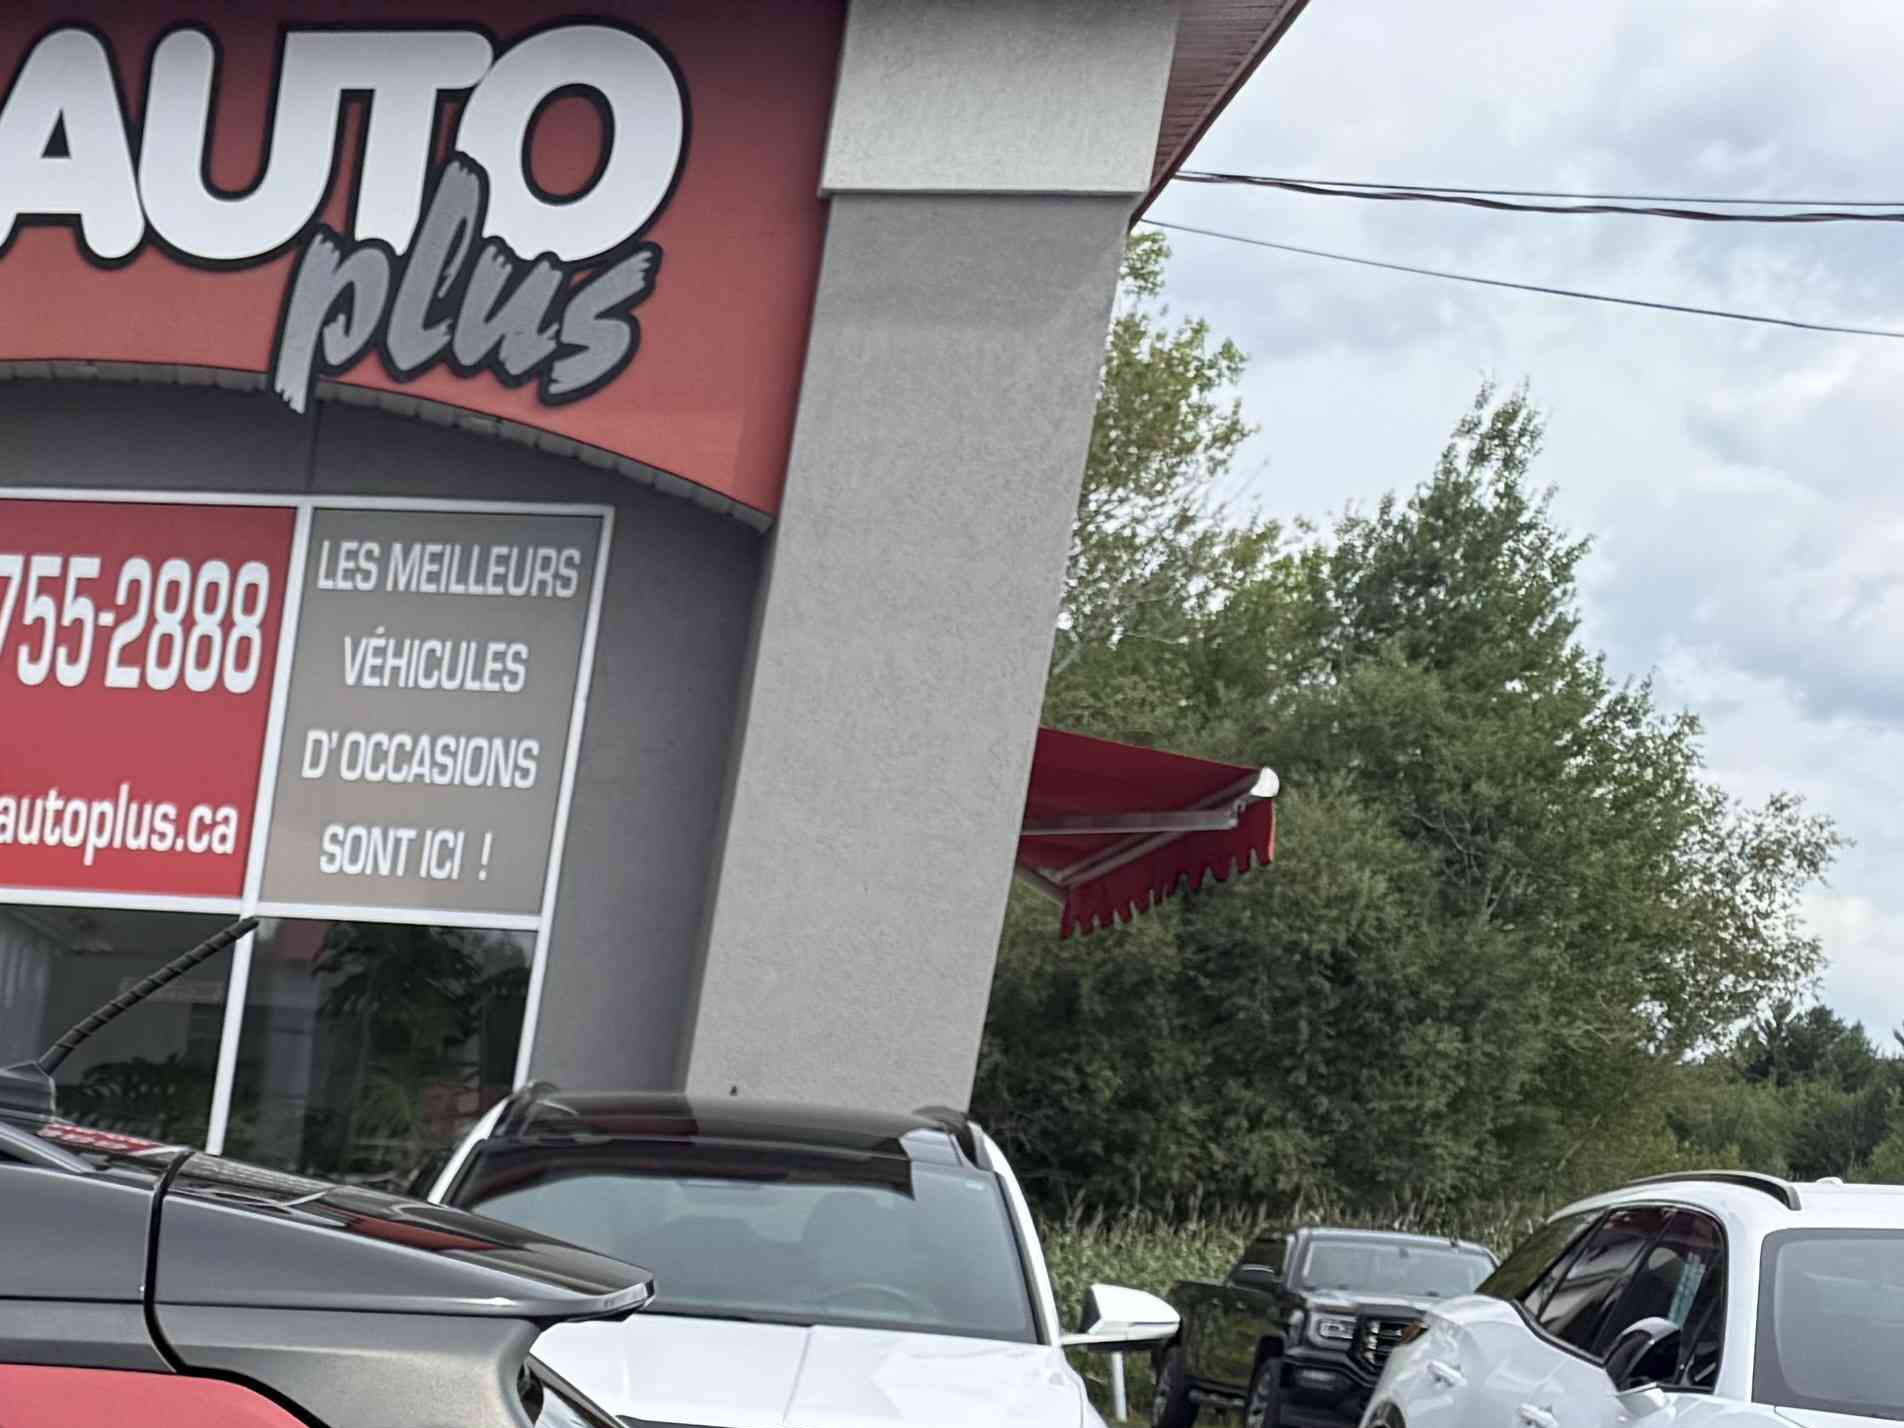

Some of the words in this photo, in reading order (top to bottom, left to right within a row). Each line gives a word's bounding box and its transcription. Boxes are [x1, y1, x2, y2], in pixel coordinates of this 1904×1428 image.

[274, 150, 662, 412] plus
[316, 540, 380, 591] LES
[385, 542, 581, 598] MEILLEURS
[343, 625, 529, 693] VÉHICULES
[319, 824, 417, 876] SONT
[419, 829, 465, 880] ICI
